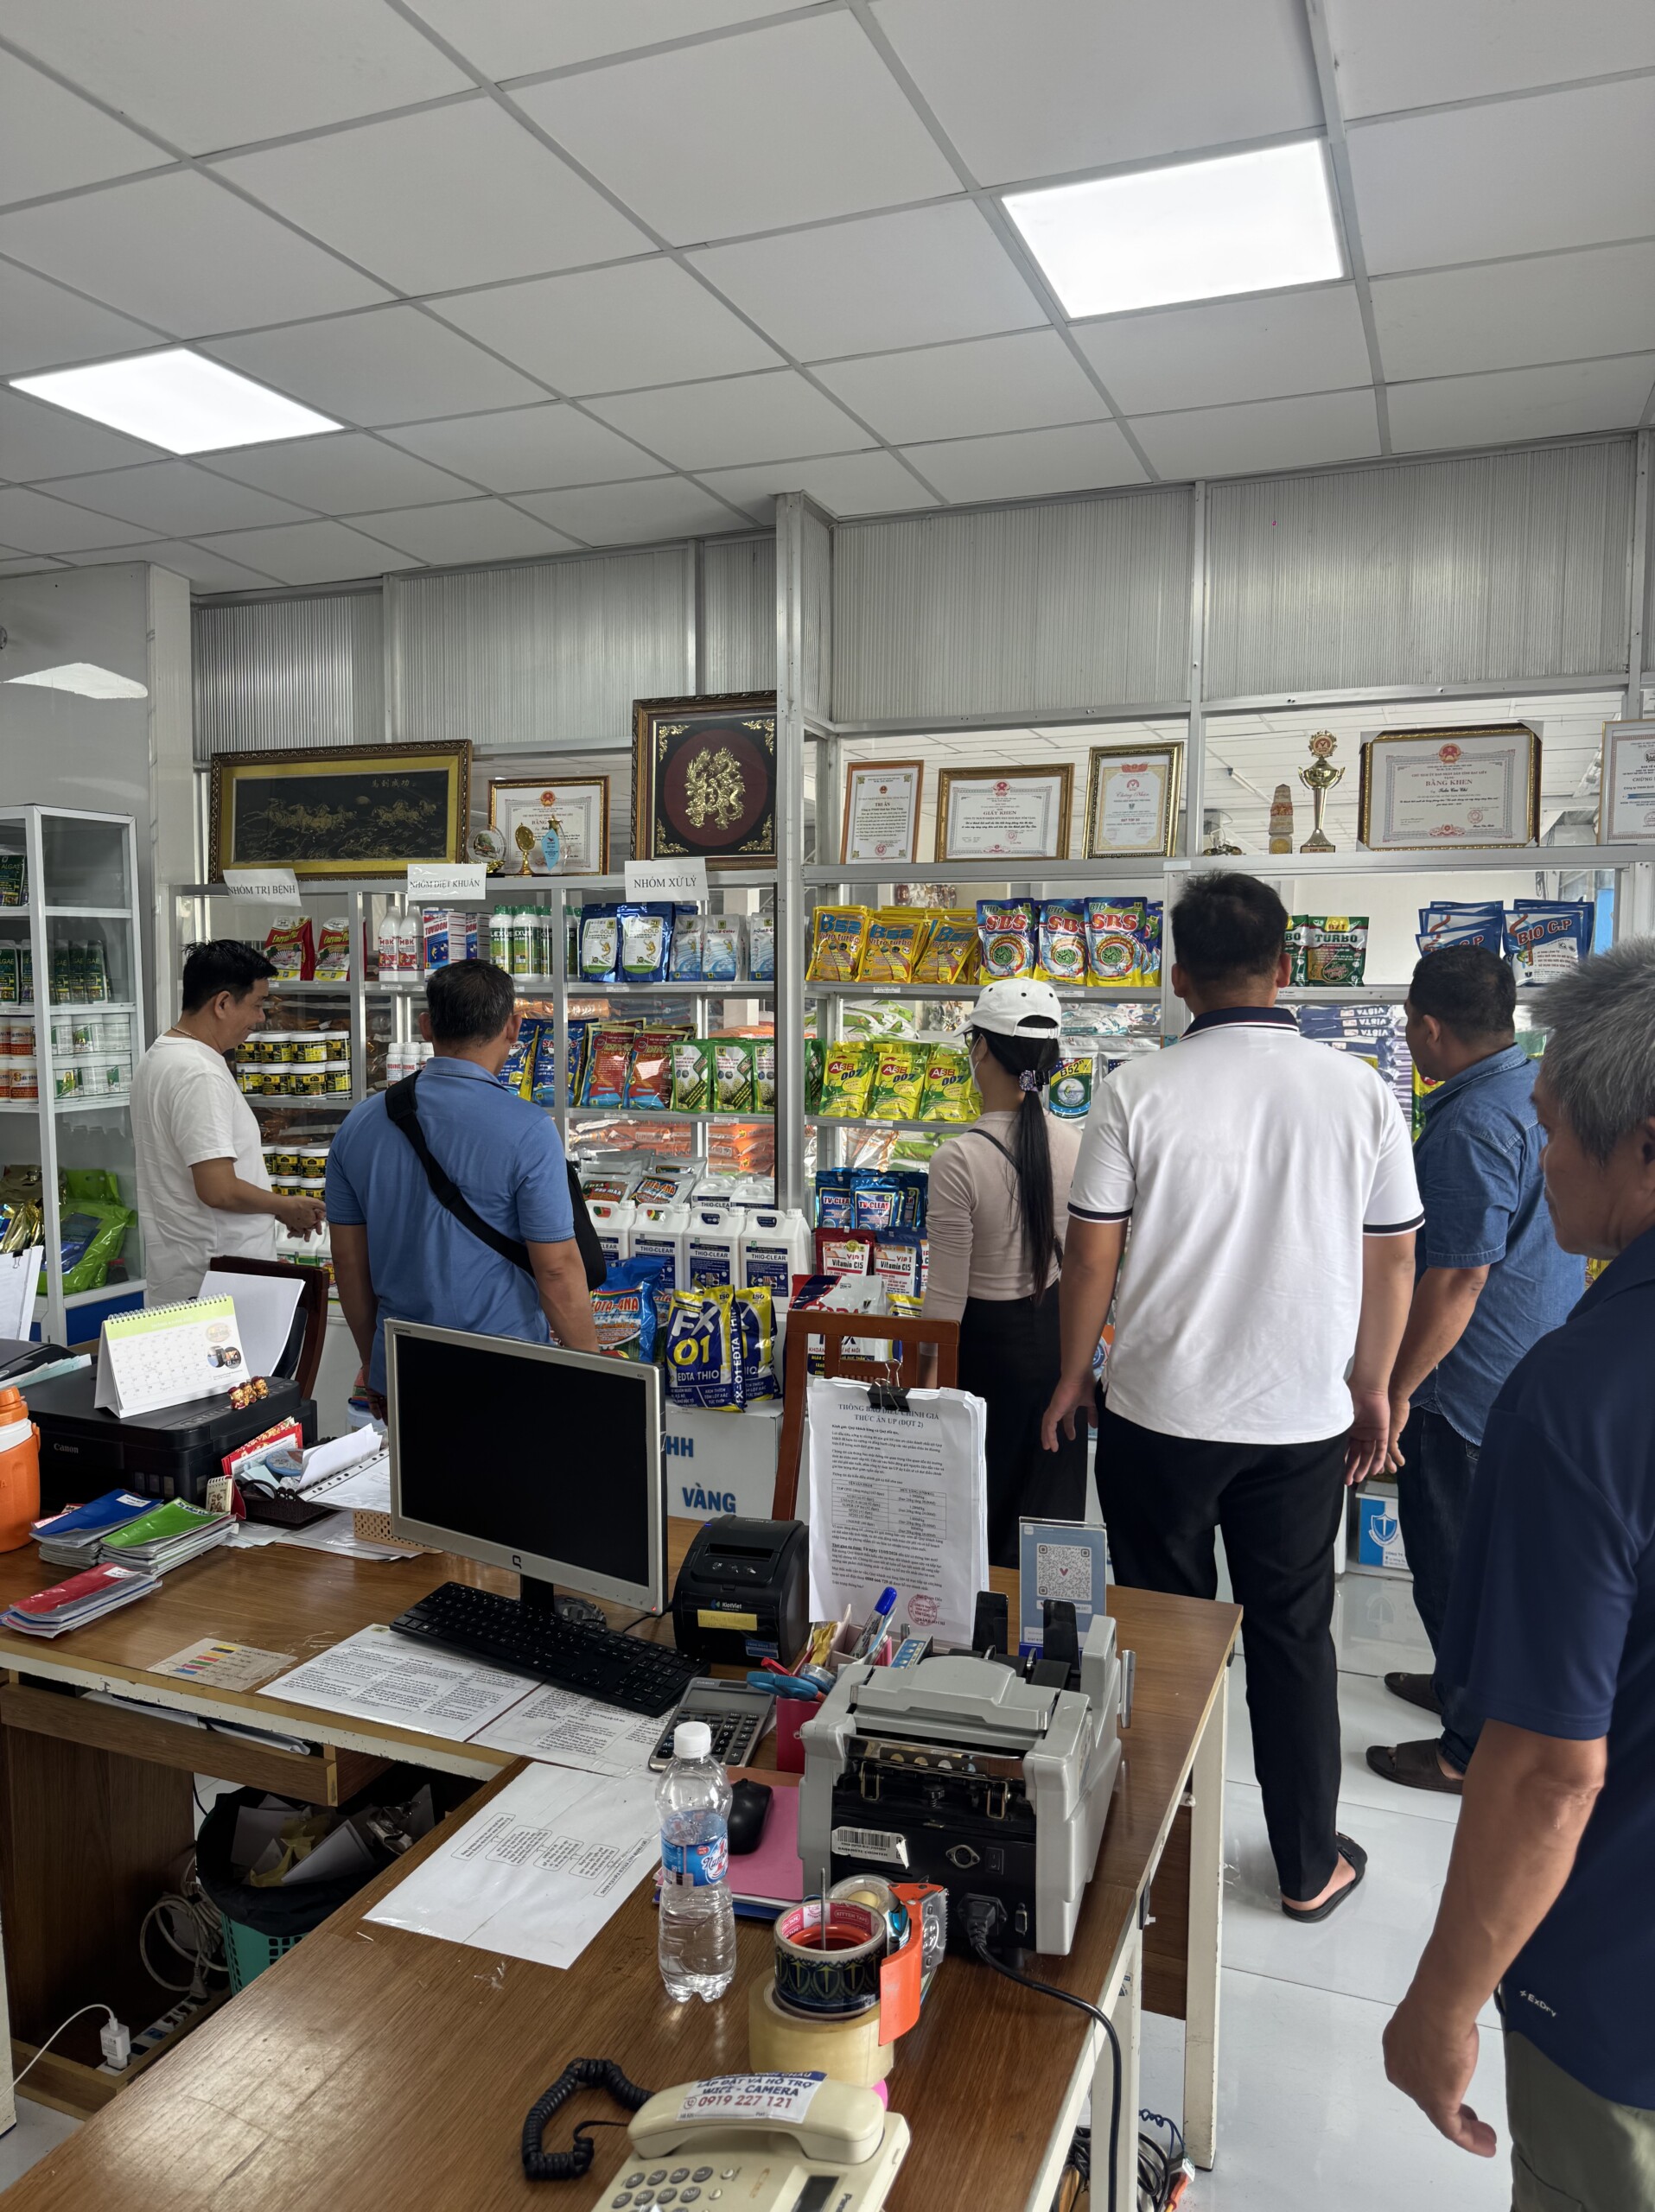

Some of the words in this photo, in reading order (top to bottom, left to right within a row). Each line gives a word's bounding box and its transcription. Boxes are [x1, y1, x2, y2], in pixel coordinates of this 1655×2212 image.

[410, 880, 433, 889] NHÓM
[453, 878, 481, 888] KHUẨN
[633, 876, 665, 888] NHÓM
[669, 878, 684, 887] XỬ
[228, 885, 253, 895] NHÓM
[255, 886, 270, 895] TRỊ
[272, 884, 296, 895] BỆNH
[1047, 906, 1065, 914] BIO
[1089, 902, 1106, 911] BIO
[820, 913, 862, 935] B52
[985, 913, 1027, 931] SBS
[1091, 913, 1139, 931] SBS
[425, 921, 448, 935] TOVIDON
[869, 925, 913, 940] B52
[1518, 925, 1544, 945] BIO
[1547, 918, 1572, 935] C.P
[819, 932, 836, 942] Nitro
[837, 933, 861, 944] turbo
[869, 938, 888, 946] Nitro
[889, 938, 913, 947] turbo
[1314, 934, 1358, 943] TURBO
[1357, 1007, 1384, 1016] VISTA
[830, 1062, 854, 1071] ABB
[883, 1065, 907, 1074] ABB
[1060, 1063, 1079, 1077] B52
[840, 1069, 863, 1081] 007
[893, 1073, 916, 1083] 007
[931, 1068, 955, 1077] ABB
[941, 1075, 964, 1086] 007
[831, 1260, 852, 1268] Vitamin
[854, 1261, 863, 1269] C15
[882, 1261, 901, 1270] Vitamin
[902, 1262, 911, 1271] C15
[672, 1305, 718, 1337] FX
[674, 1335, 710, 1365] 01
[731, 1338, 742, 1366] EDTA
[678, 1373, 694, 1382] EDTA
[697, 1370, 719, 1380] THIO
[838, 1403, 864, 1412] THÔNG
[926, 1411, 939, 1420] GIÁ
[54, 1443, 79, 1454] Canon
[682, 1482, 736, 1514] VÀNG
[856, 1914, 869, 1923] TAPE
[697, 2080, 719, 2088] LẮP
[787, 2079, 814, 2088] TRỢ
[745, 2085, 799, 2096] CAMERA
[698, 2095, 733, 2107] 0919
[735, 2095, 763, 2106] 227
[767, 2096, 792, 2108] 121
